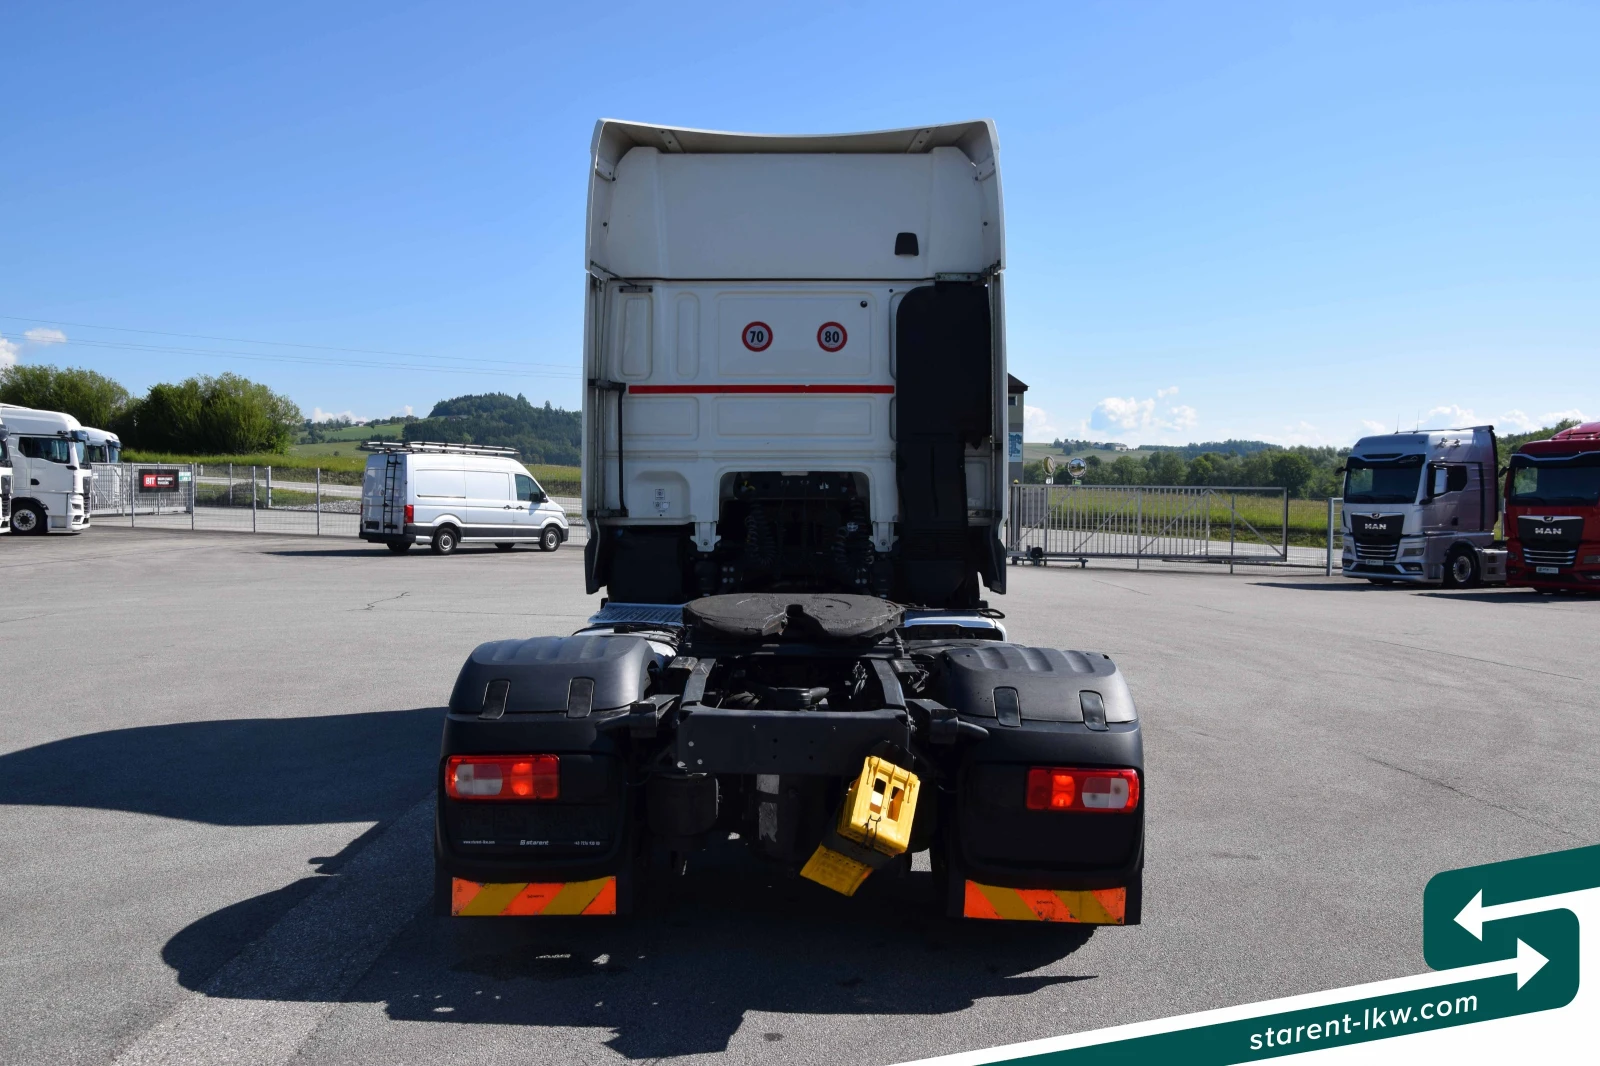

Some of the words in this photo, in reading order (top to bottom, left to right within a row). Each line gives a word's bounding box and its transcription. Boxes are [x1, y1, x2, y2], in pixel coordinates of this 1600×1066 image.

[749, 330, 764, 343] 70
[824, 330, 840, 343] 80
[145, 477, 156, 485] BIT
[1534, 527, 1562, 535] MAN
